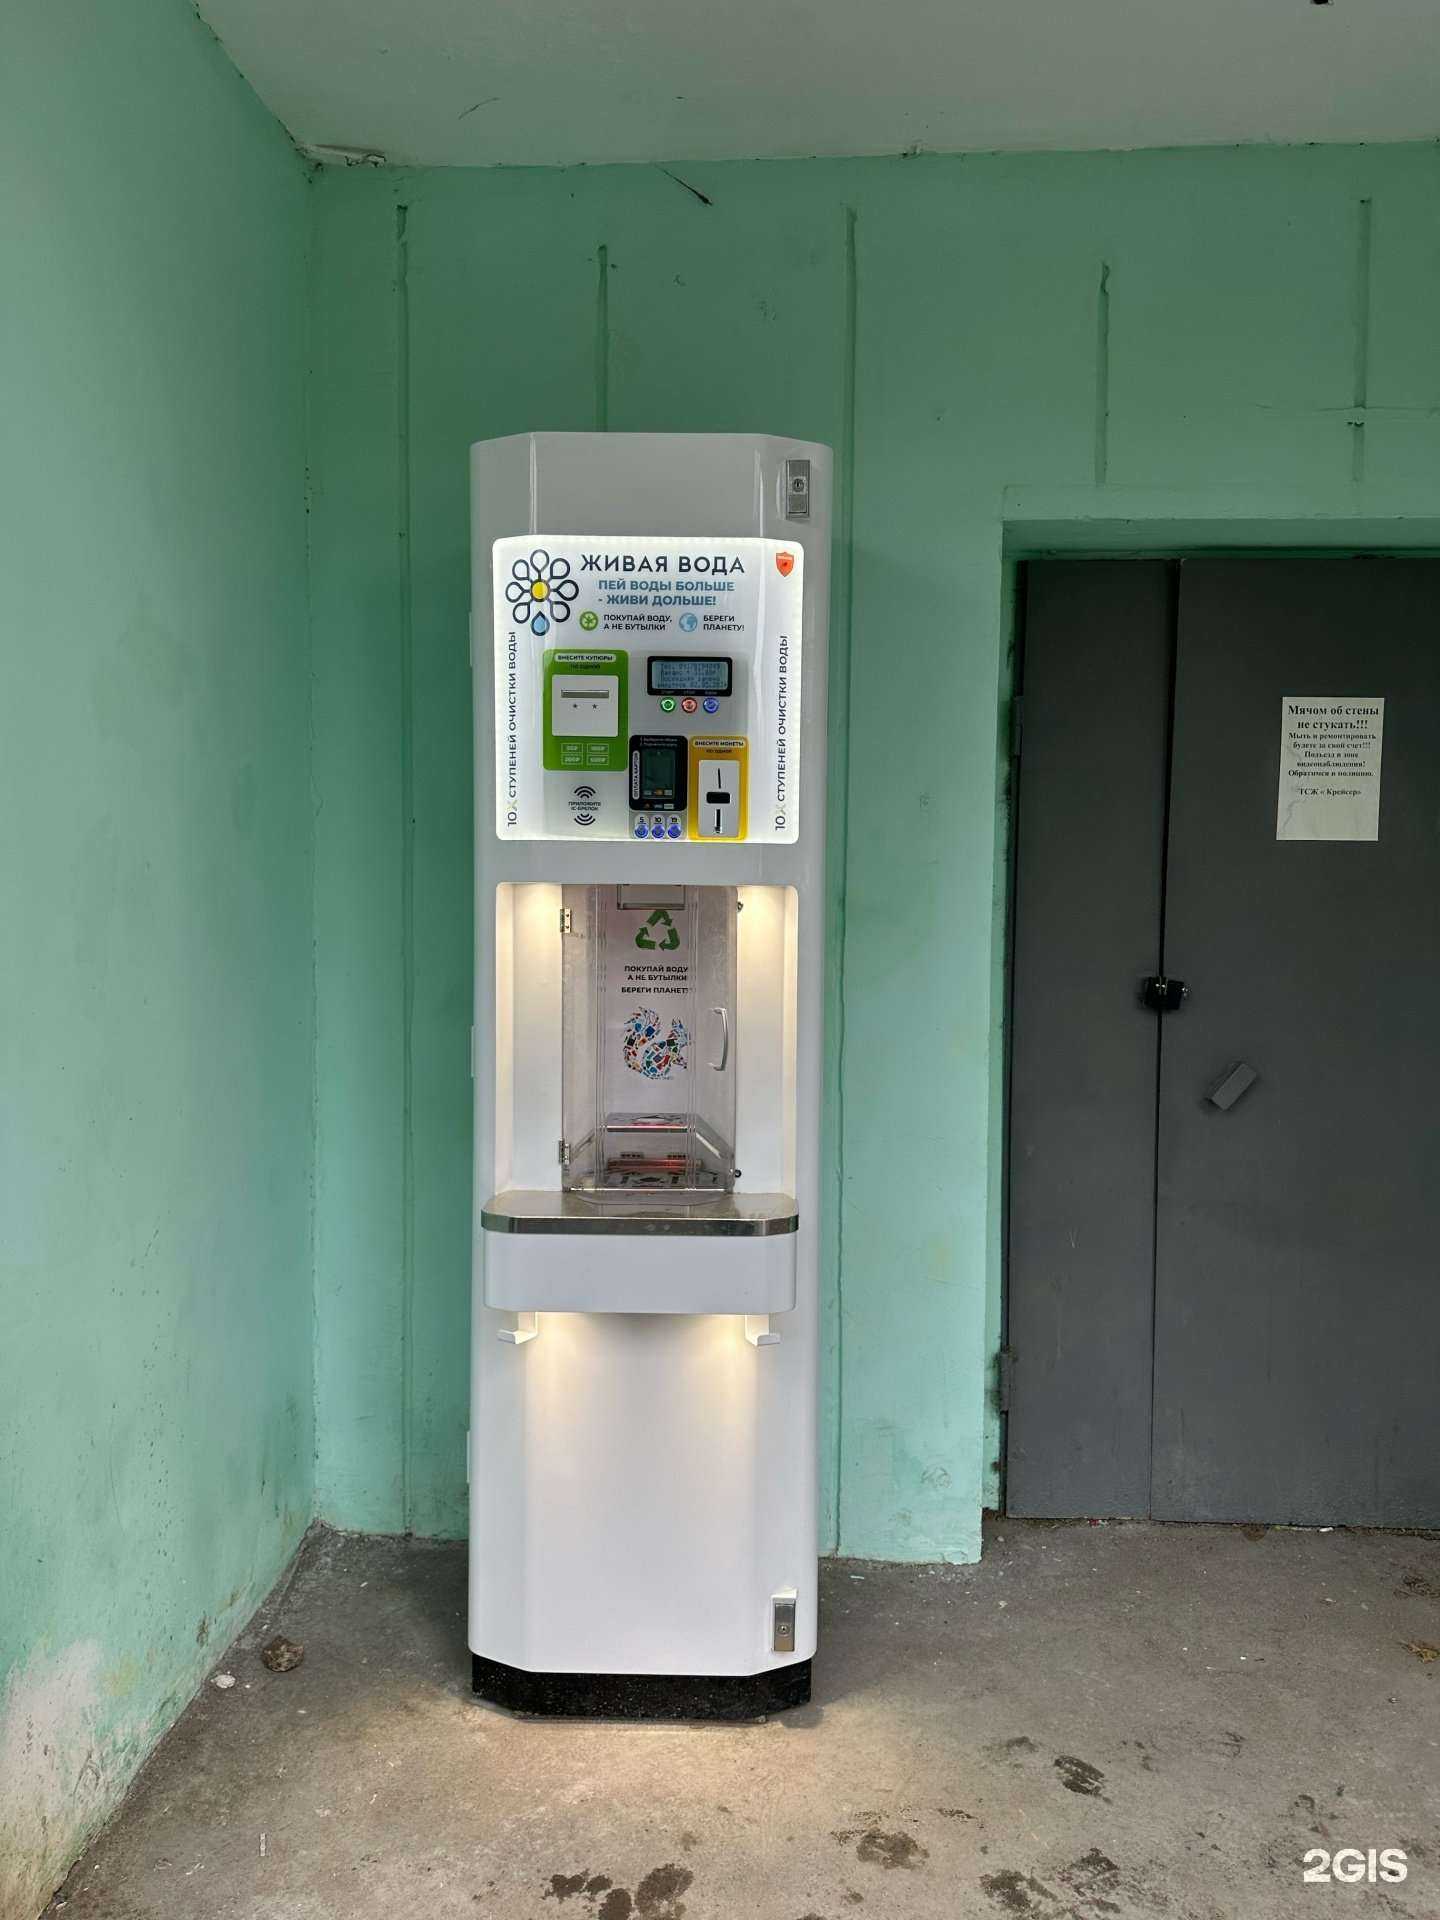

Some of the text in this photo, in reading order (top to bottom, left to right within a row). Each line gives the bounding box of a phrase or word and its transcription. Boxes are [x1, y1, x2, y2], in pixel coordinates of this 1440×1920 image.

[580, 554, 745, 576] ЖИВАЯ ВОДА
[599, 578, 736, 592] ПЕЙ ВОДЫ БОЛЬШЕ
[606, 594, 649, 605] ЖИВИ
[652, 595, 717, 606] ДОЛЬШЕ!
[604, 613, 673, 623] ПОКУПАЙ ВОДУ,
[703, 624, 745, 632] ПЛАНЕТУ!
[508, 631, 517, 669] ВОДЫ
[778, 635, 788, 674] ВОДЫ
[508, 672, 517, 731] ОЧИСТКИ
[777, 677, 787, 735] ОЧИСТКИ
[1288, 705, 1327, 715] Мячом
[1330, 706, 1342, 715] об
[1312, 720, 1368, 732] стукать!!!
[507, 734, 517, 798] СТУПЕНЕЙ
[776, 738, 786, 802] СТУПЕНЕЙ
[624, 964, 664, 972] ПОКУПАЙ
